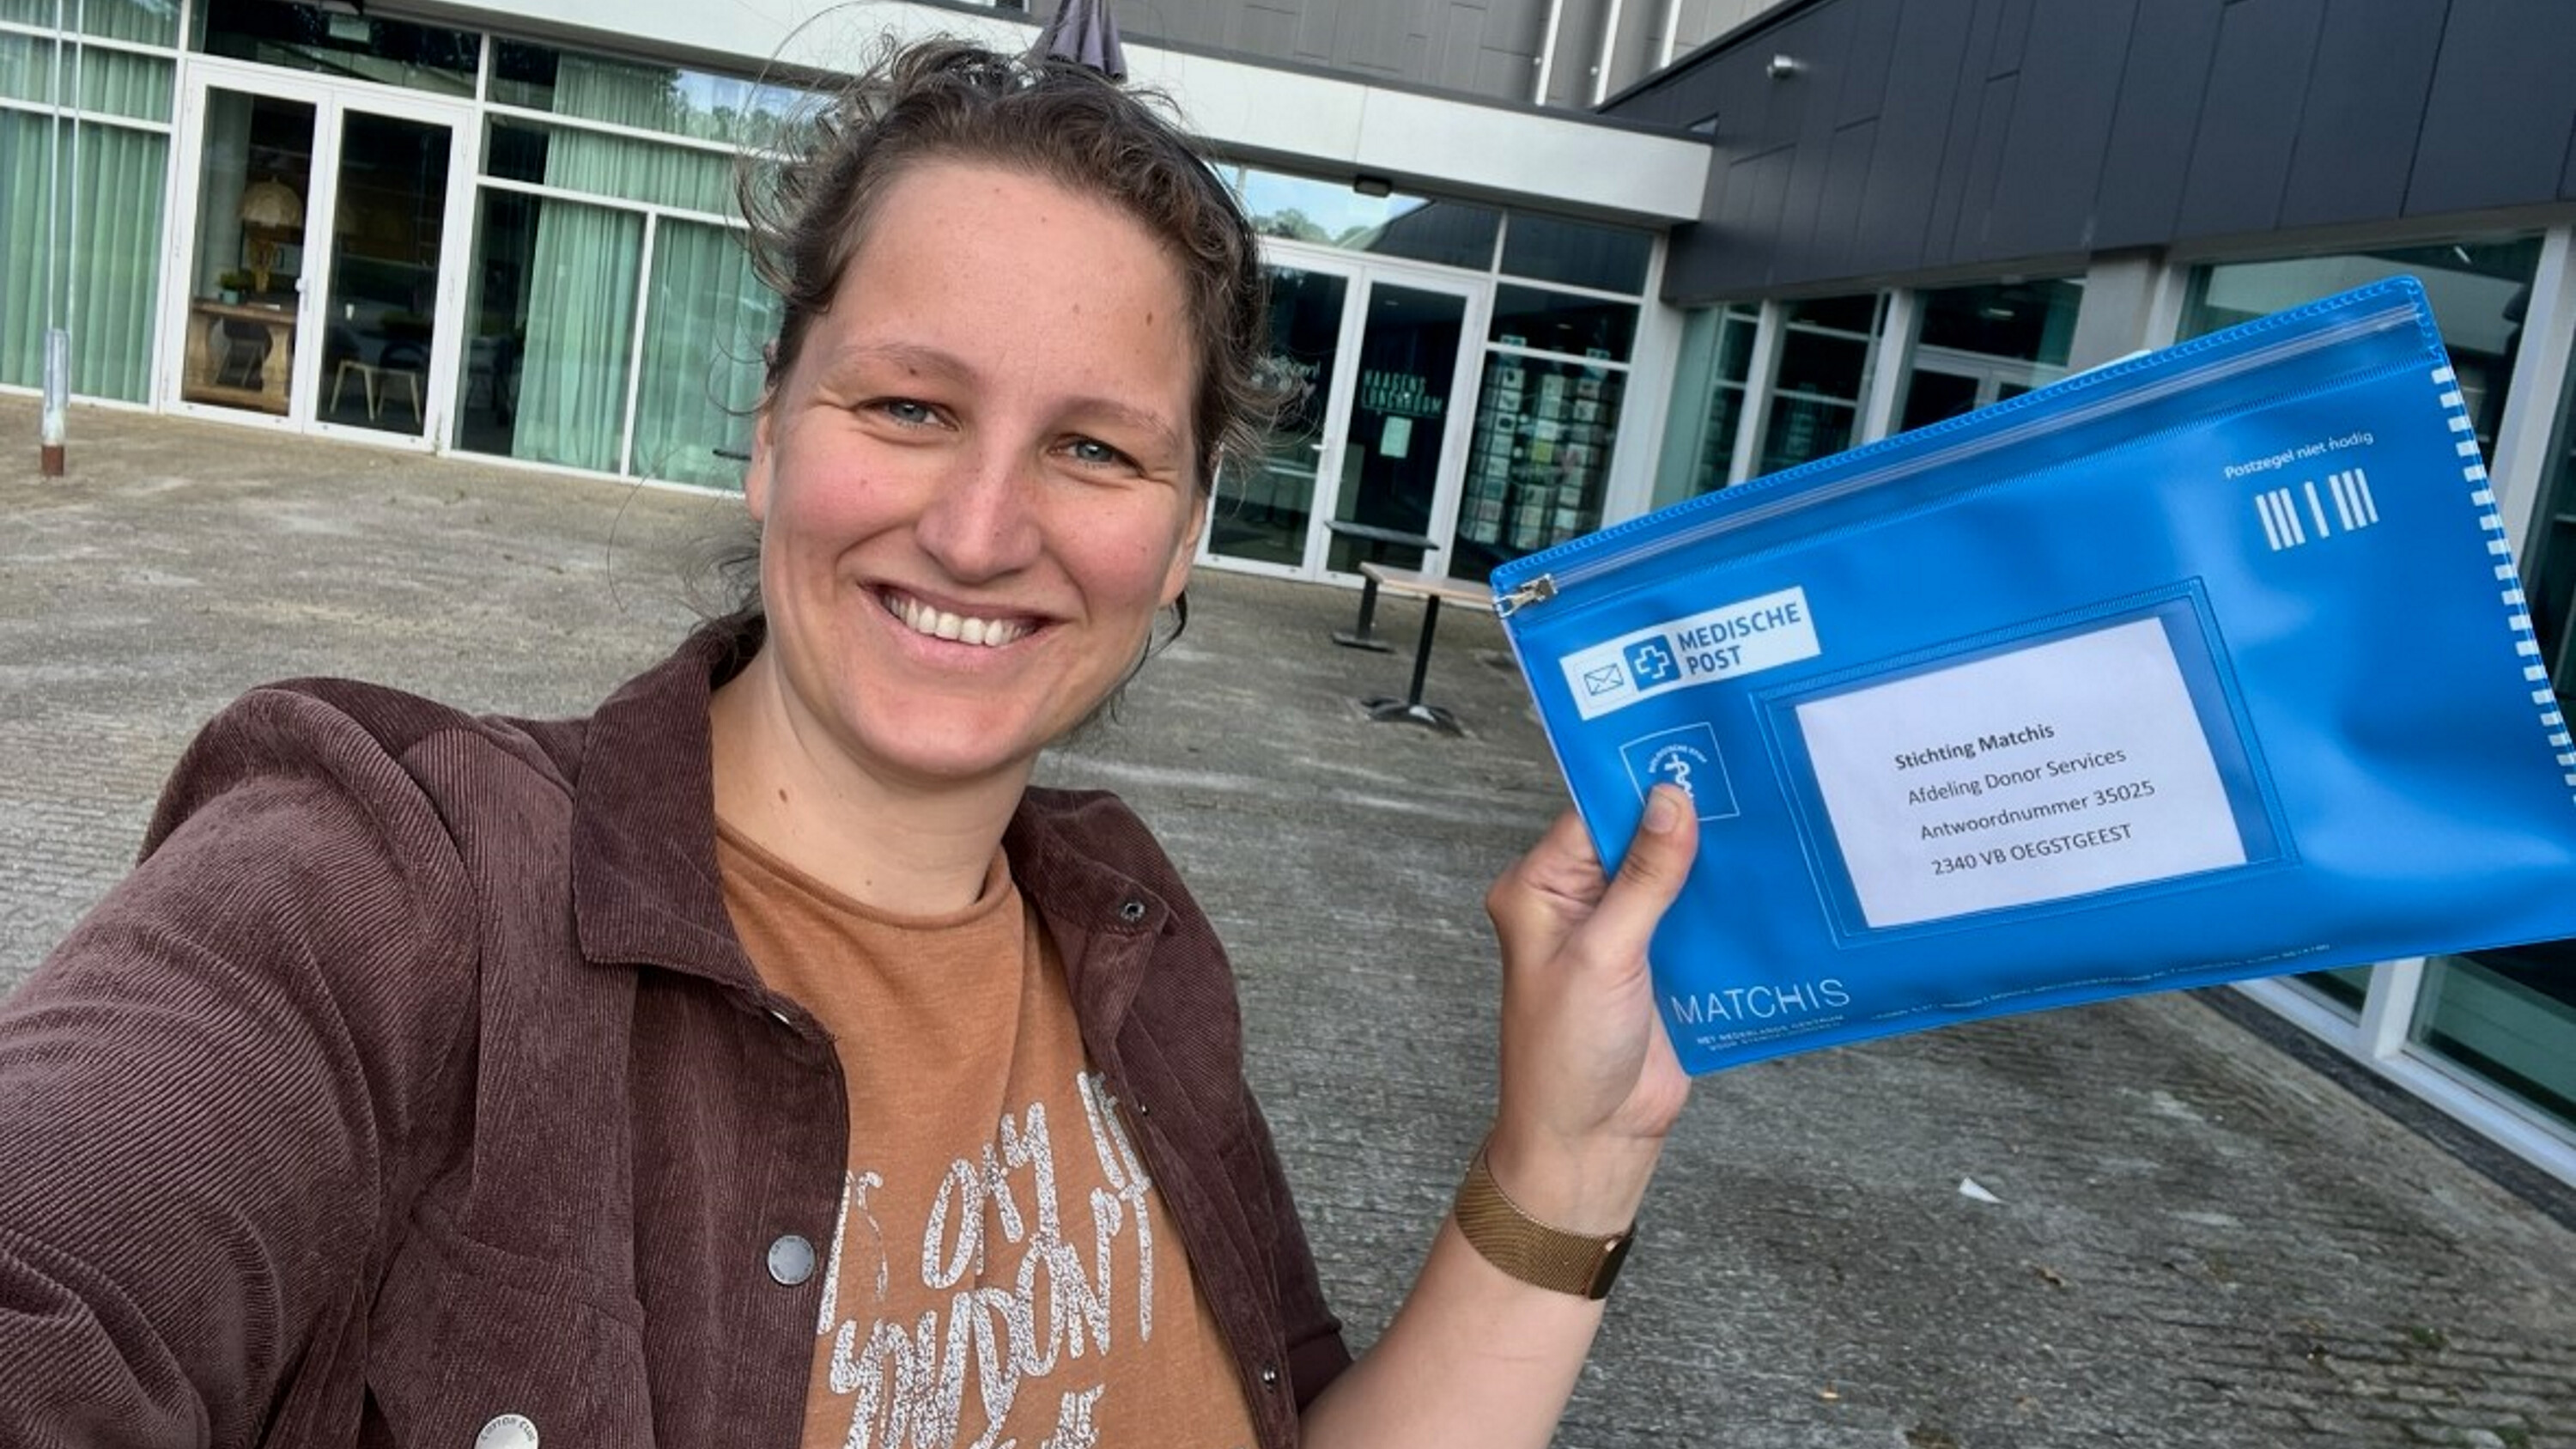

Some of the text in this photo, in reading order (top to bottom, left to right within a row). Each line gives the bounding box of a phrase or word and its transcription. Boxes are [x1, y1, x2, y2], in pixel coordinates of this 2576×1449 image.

[2224, 448, 2295, 479] Postzegel
[2296, 442, 2327, 460] niet
[1677, 602, 1801, 652] MEDISCHE
[1686, 645, 1742, 676] POST
[1894, 723, 2055, 770] Stichting Matchis
[1908, 748, 2126, 807] Afdeling Donor Services
[1920, 780, 2155, 841] Antwoordnummer 35025
[1932, 822, 2131, 875] 2340 VB OEGSTGEEST
[1671, 979, 1850, 1025] MATCHIS
